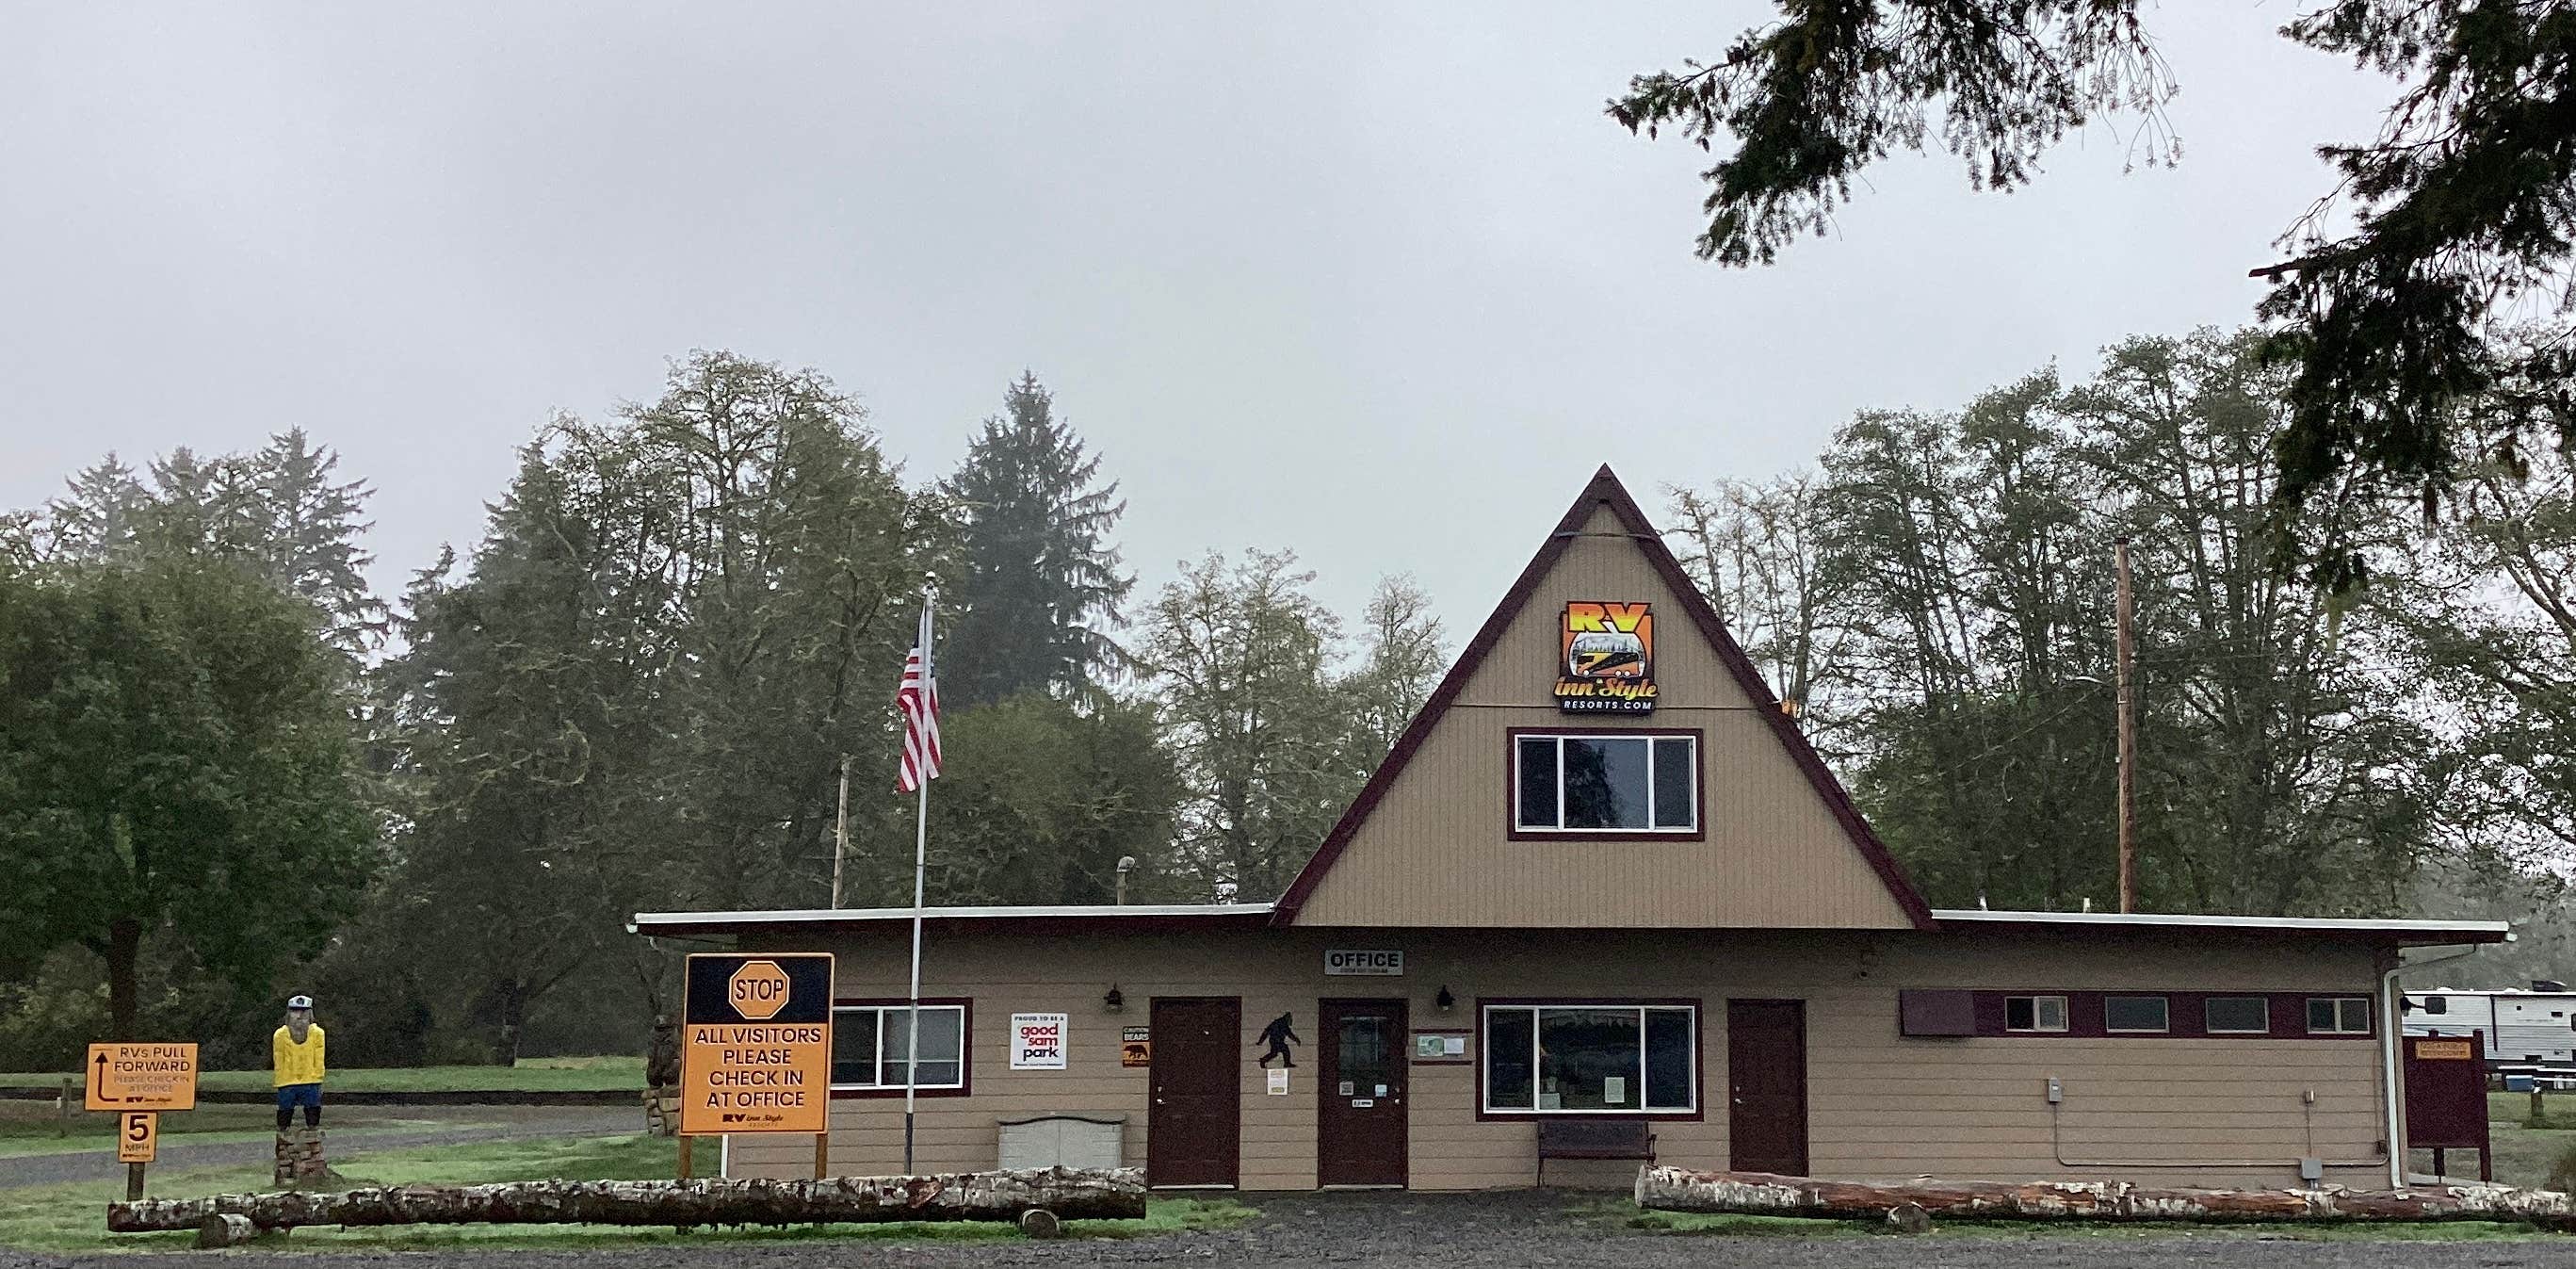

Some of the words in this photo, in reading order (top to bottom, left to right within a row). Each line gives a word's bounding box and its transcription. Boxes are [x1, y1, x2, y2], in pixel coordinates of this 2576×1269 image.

[1567, 601, 1652, 633] RV
[1598, 678, 1659, 700] Style
[1330, 952, 1400, 968] OFFICE
[735, 979, 784, 1001] STOP
[694, 1029, 727, 1044] ALL
[733, 1028, 821, 1043] VISITORS
[1020, 1023, 1059, 1039] good
[1124, 1033, 1149, 1041] BEARS
[1028, 1037, 1058, 1046] sam
[120, 1047, 149, 1058] RVs
[153, 1047, 186, 1058] PULL
[722, 1049, 791, 1065] PLEASE
[1023, 1047, 1059, 1062] park
[114, 1061, 190, 1072] FORWARD
[709, 1070, 779, 1086] CHECK
[784, 1070, 803, 1085] IN
[706, 1092, 732, 1108] AT
[737, 1091, 804, 1107] OFFICE
[722, 1114, 746, 1122] RV
[128, 1114, 149, 1142] 5
